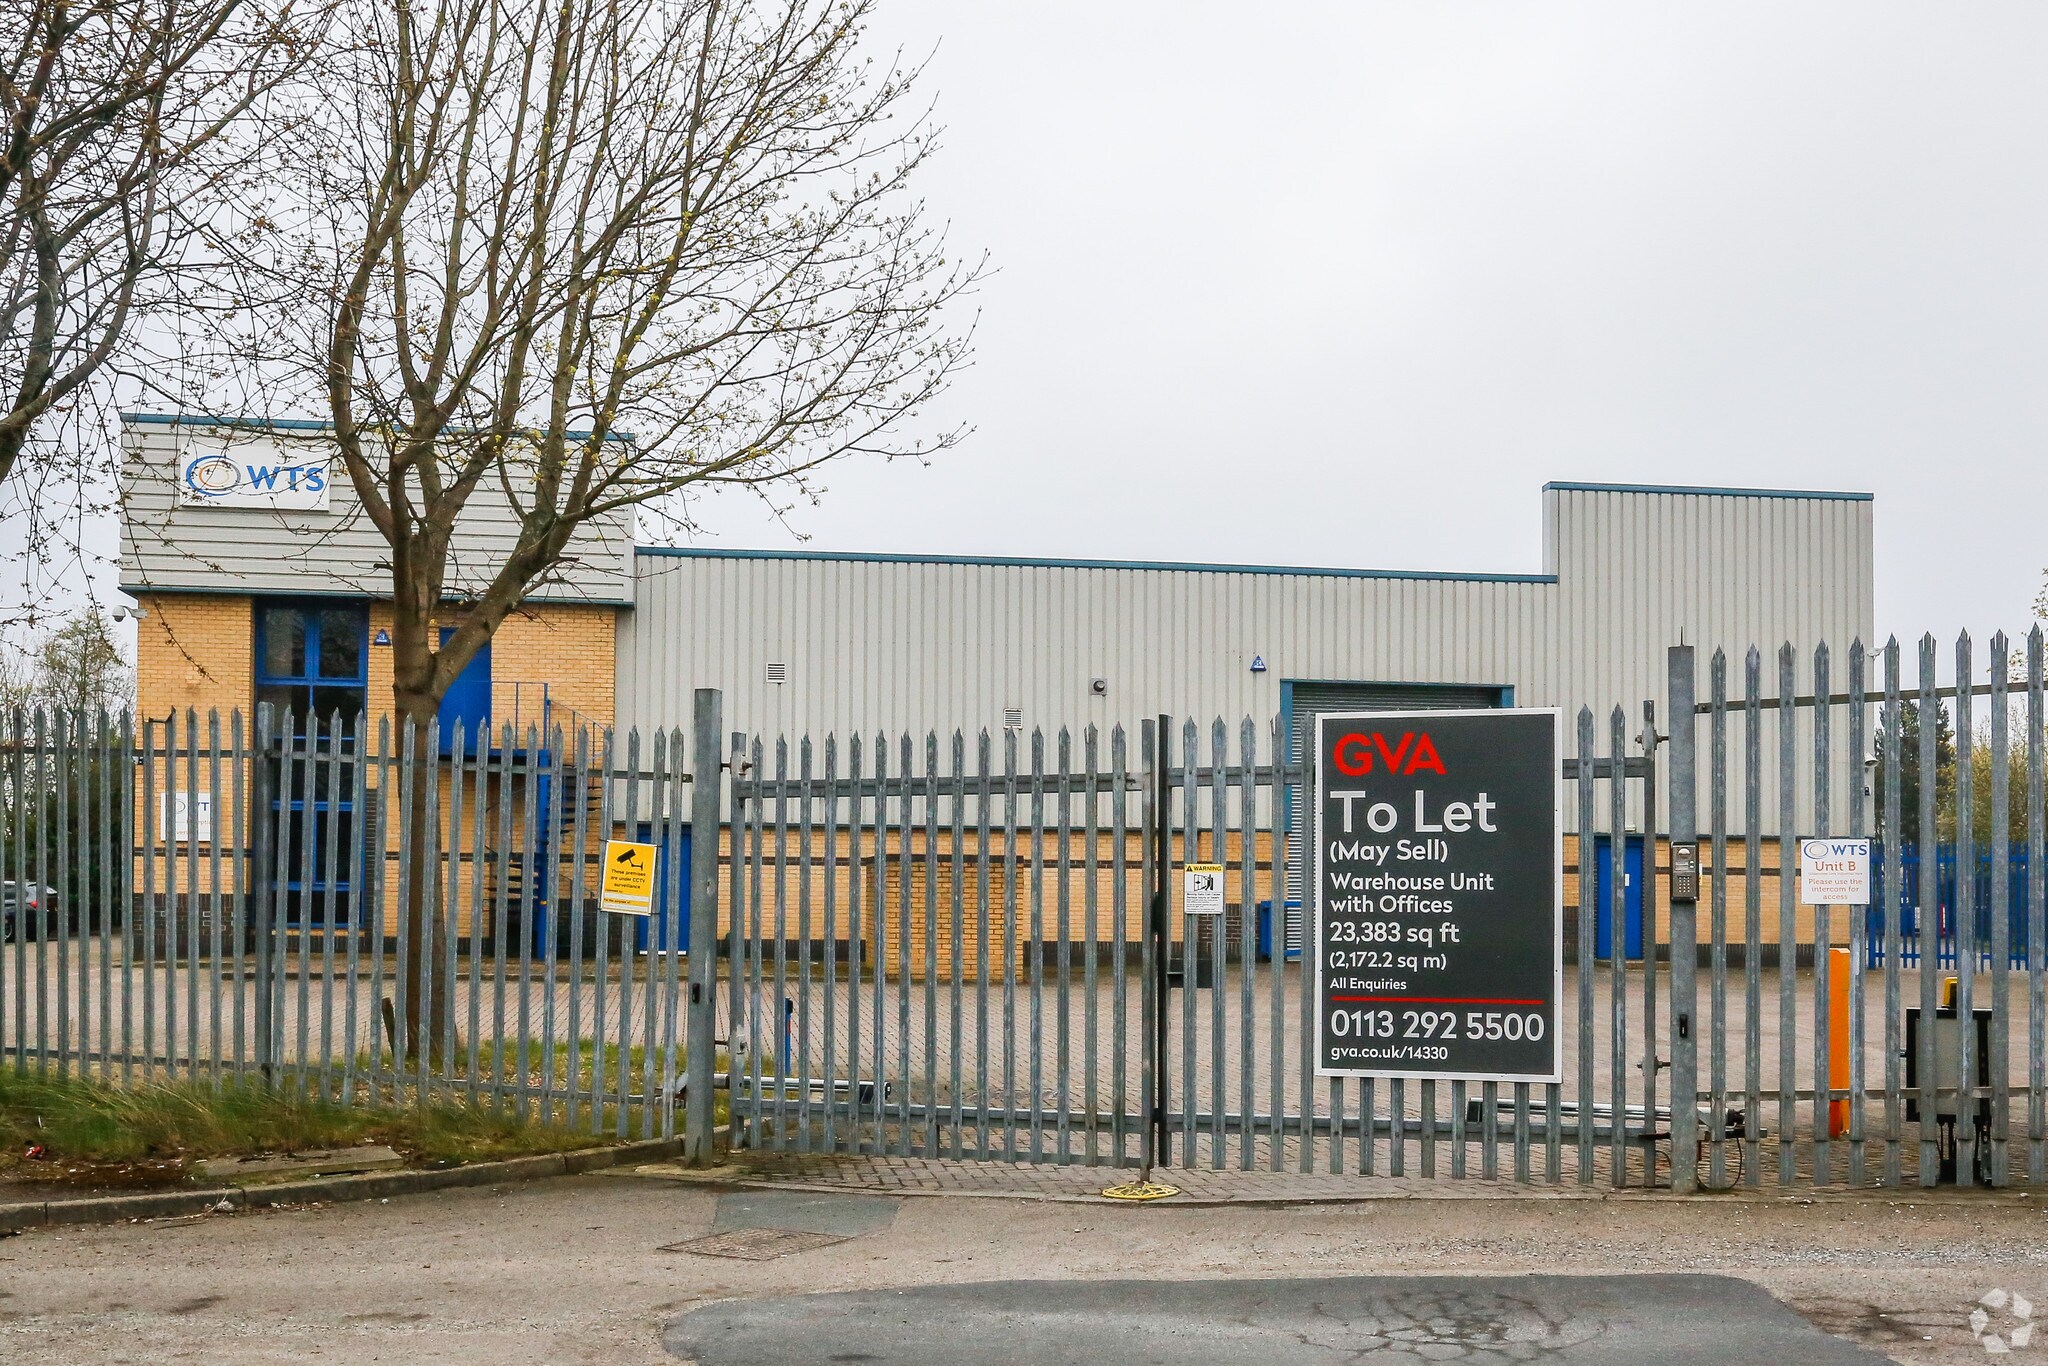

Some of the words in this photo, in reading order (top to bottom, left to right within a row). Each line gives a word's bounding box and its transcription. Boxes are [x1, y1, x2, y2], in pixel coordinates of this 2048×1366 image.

[246, 465, 325, 492] WTS
[1333, 731, 1448, 777] GVA
[1329, 790, 1398, 833] To
[1415, 790, 1498, 833] Let
[1329, 840, 1391, 866] (May
[1396, 839, 1448, 863] Sell)
[1831, 844, 1867, 856] WTS
[1815, 861, 1844, 872] Unit
[1848, 861, 1856, 872] B
[1330, 872, 1444, 890] Warehouse
[1450, 872, 1494, 890] Unit
[1330, 895, 1374, 913] with
[1379, 895, 1453, 913] Offices
[1329, 921, 1401, 944] 23,383
[1406, 927, 1433, 948] sq
[1440, 922, 1460, 943] ft
[1329, 951, 1393, 969] (2,172.2
[1397, 955, 1418, 972] sq
[1423, 953, 1447, 970] m)
[1329, 977, 1347, 989] All
[1350, 977, 1407, 992] Enquiries
[1331, 1009, 1394, 1038] 0113
[1402, 1011, 1457, 1039] 292
[1466, 1012, 1545, 1042] 5500
[1331, 1045, 1449, 1061] gva.co.uk/14330
